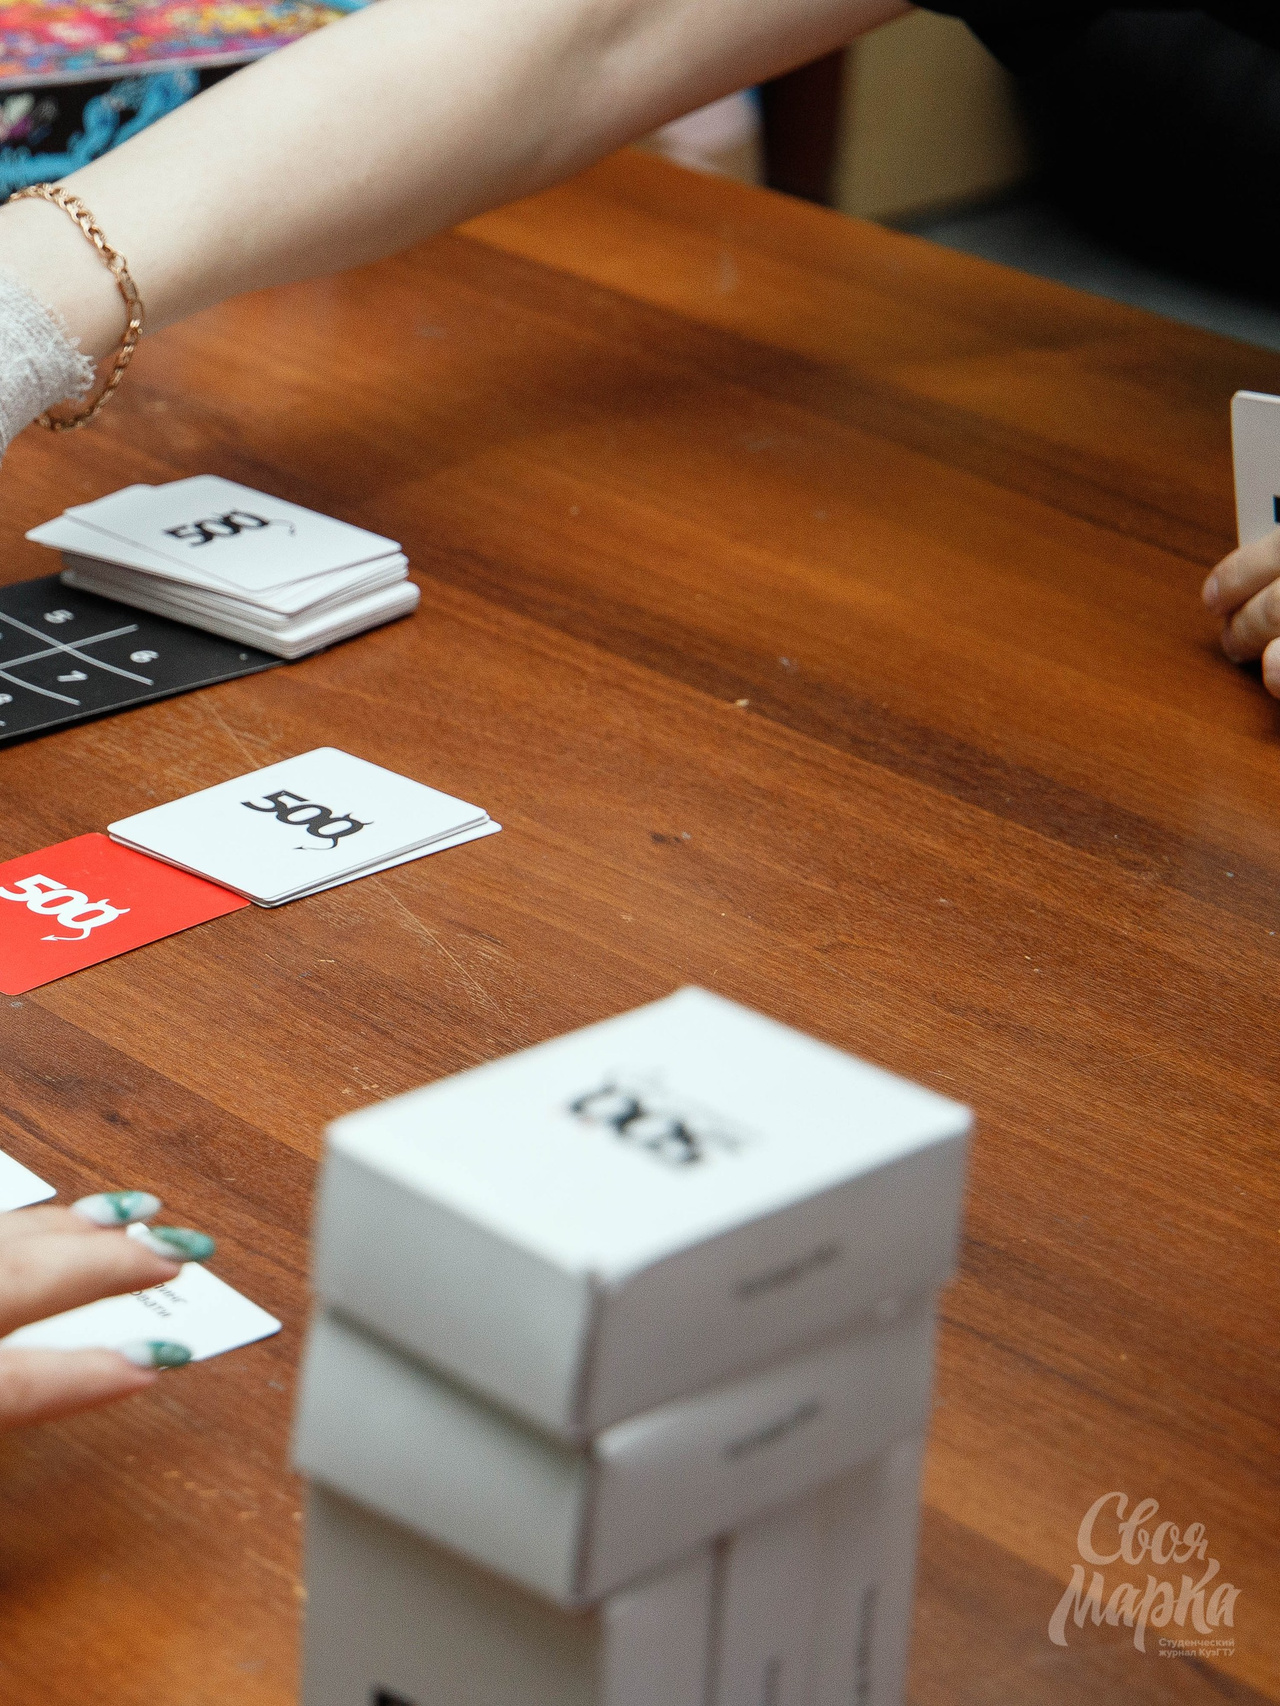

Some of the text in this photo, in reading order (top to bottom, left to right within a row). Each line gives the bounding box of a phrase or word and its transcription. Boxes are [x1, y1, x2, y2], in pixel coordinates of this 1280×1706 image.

[163, 510, 280, 549] 500
[44, 609, 74, 624] 5
[130, 650, 159, 663] 6
[57, 670, 88, 683] 7
[241, 790, 370, 847] 500
